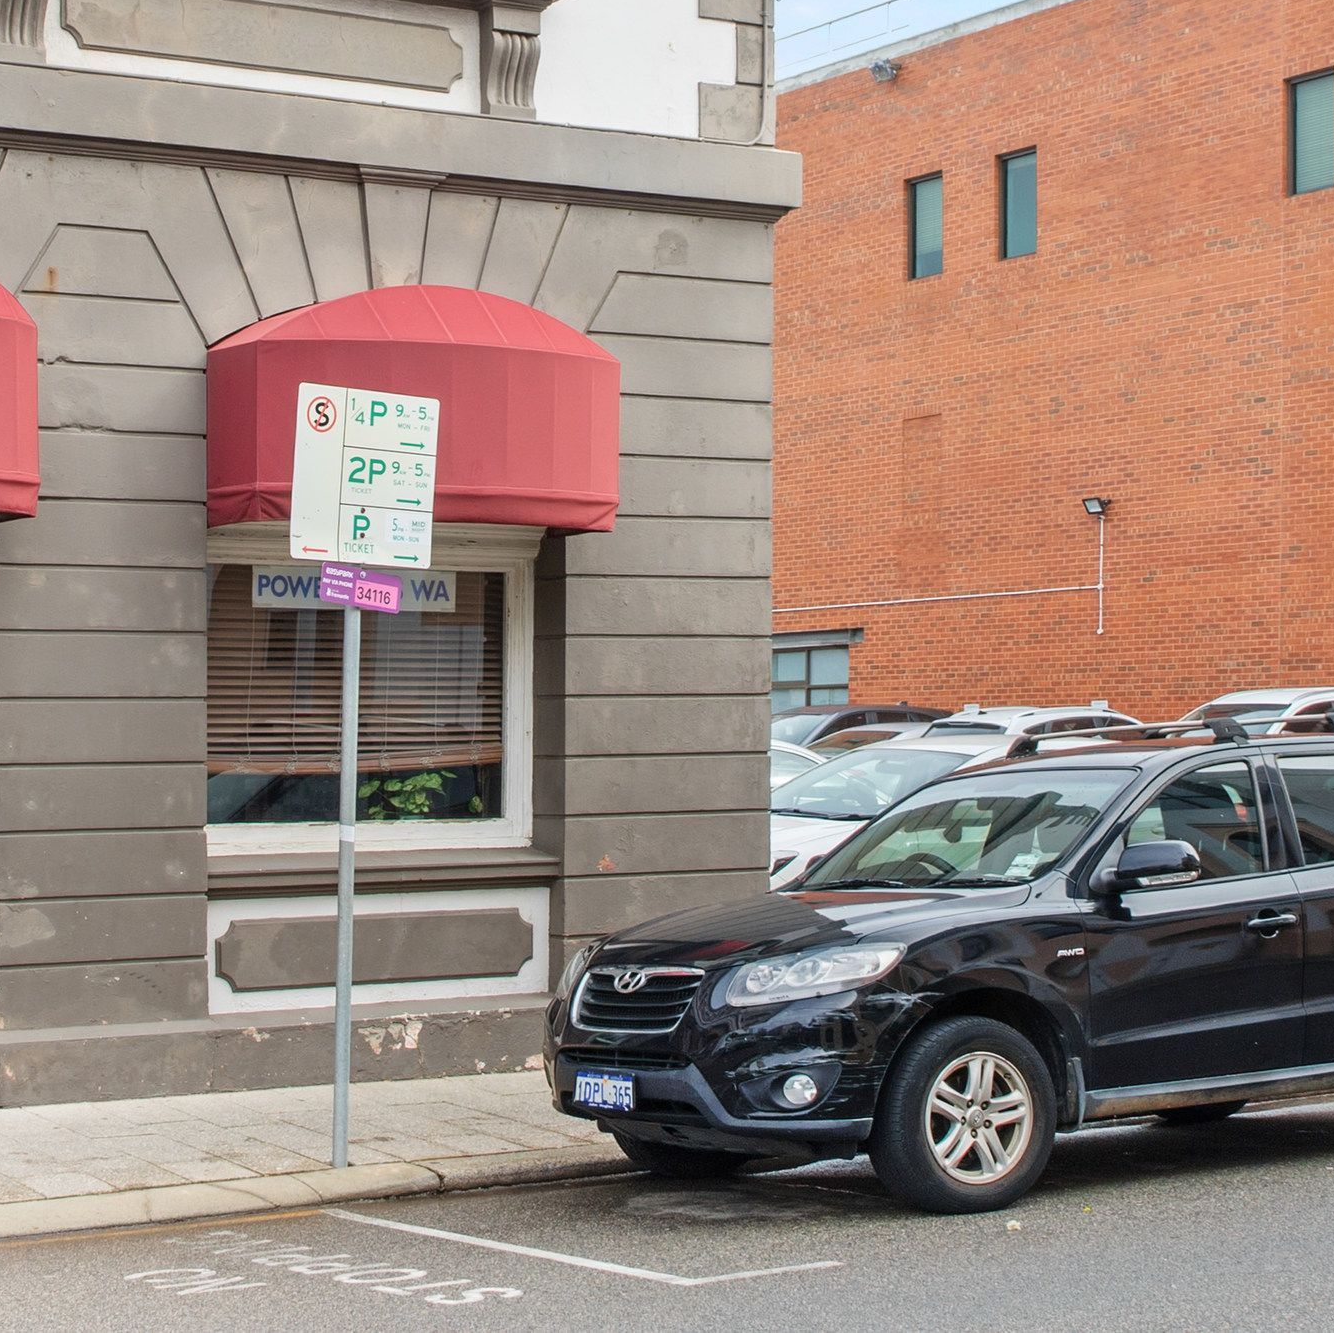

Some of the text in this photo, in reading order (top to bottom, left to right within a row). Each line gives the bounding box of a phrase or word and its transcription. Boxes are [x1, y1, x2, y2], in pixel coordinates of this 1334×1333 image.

[348, 456, 387, 484] 2P
[393, 479, 405, 487] SAT
[415, 481, 428, 489] SUN
[353, 514, 370, 540] P
[411, 520, 426, 528] MID
[344, 542, 374, 554] TICKET
[258, 574, 450, 602] POWE WA
[357, 586, 391, 605] 34116
[1057, 947, 1085, 957] AWD
